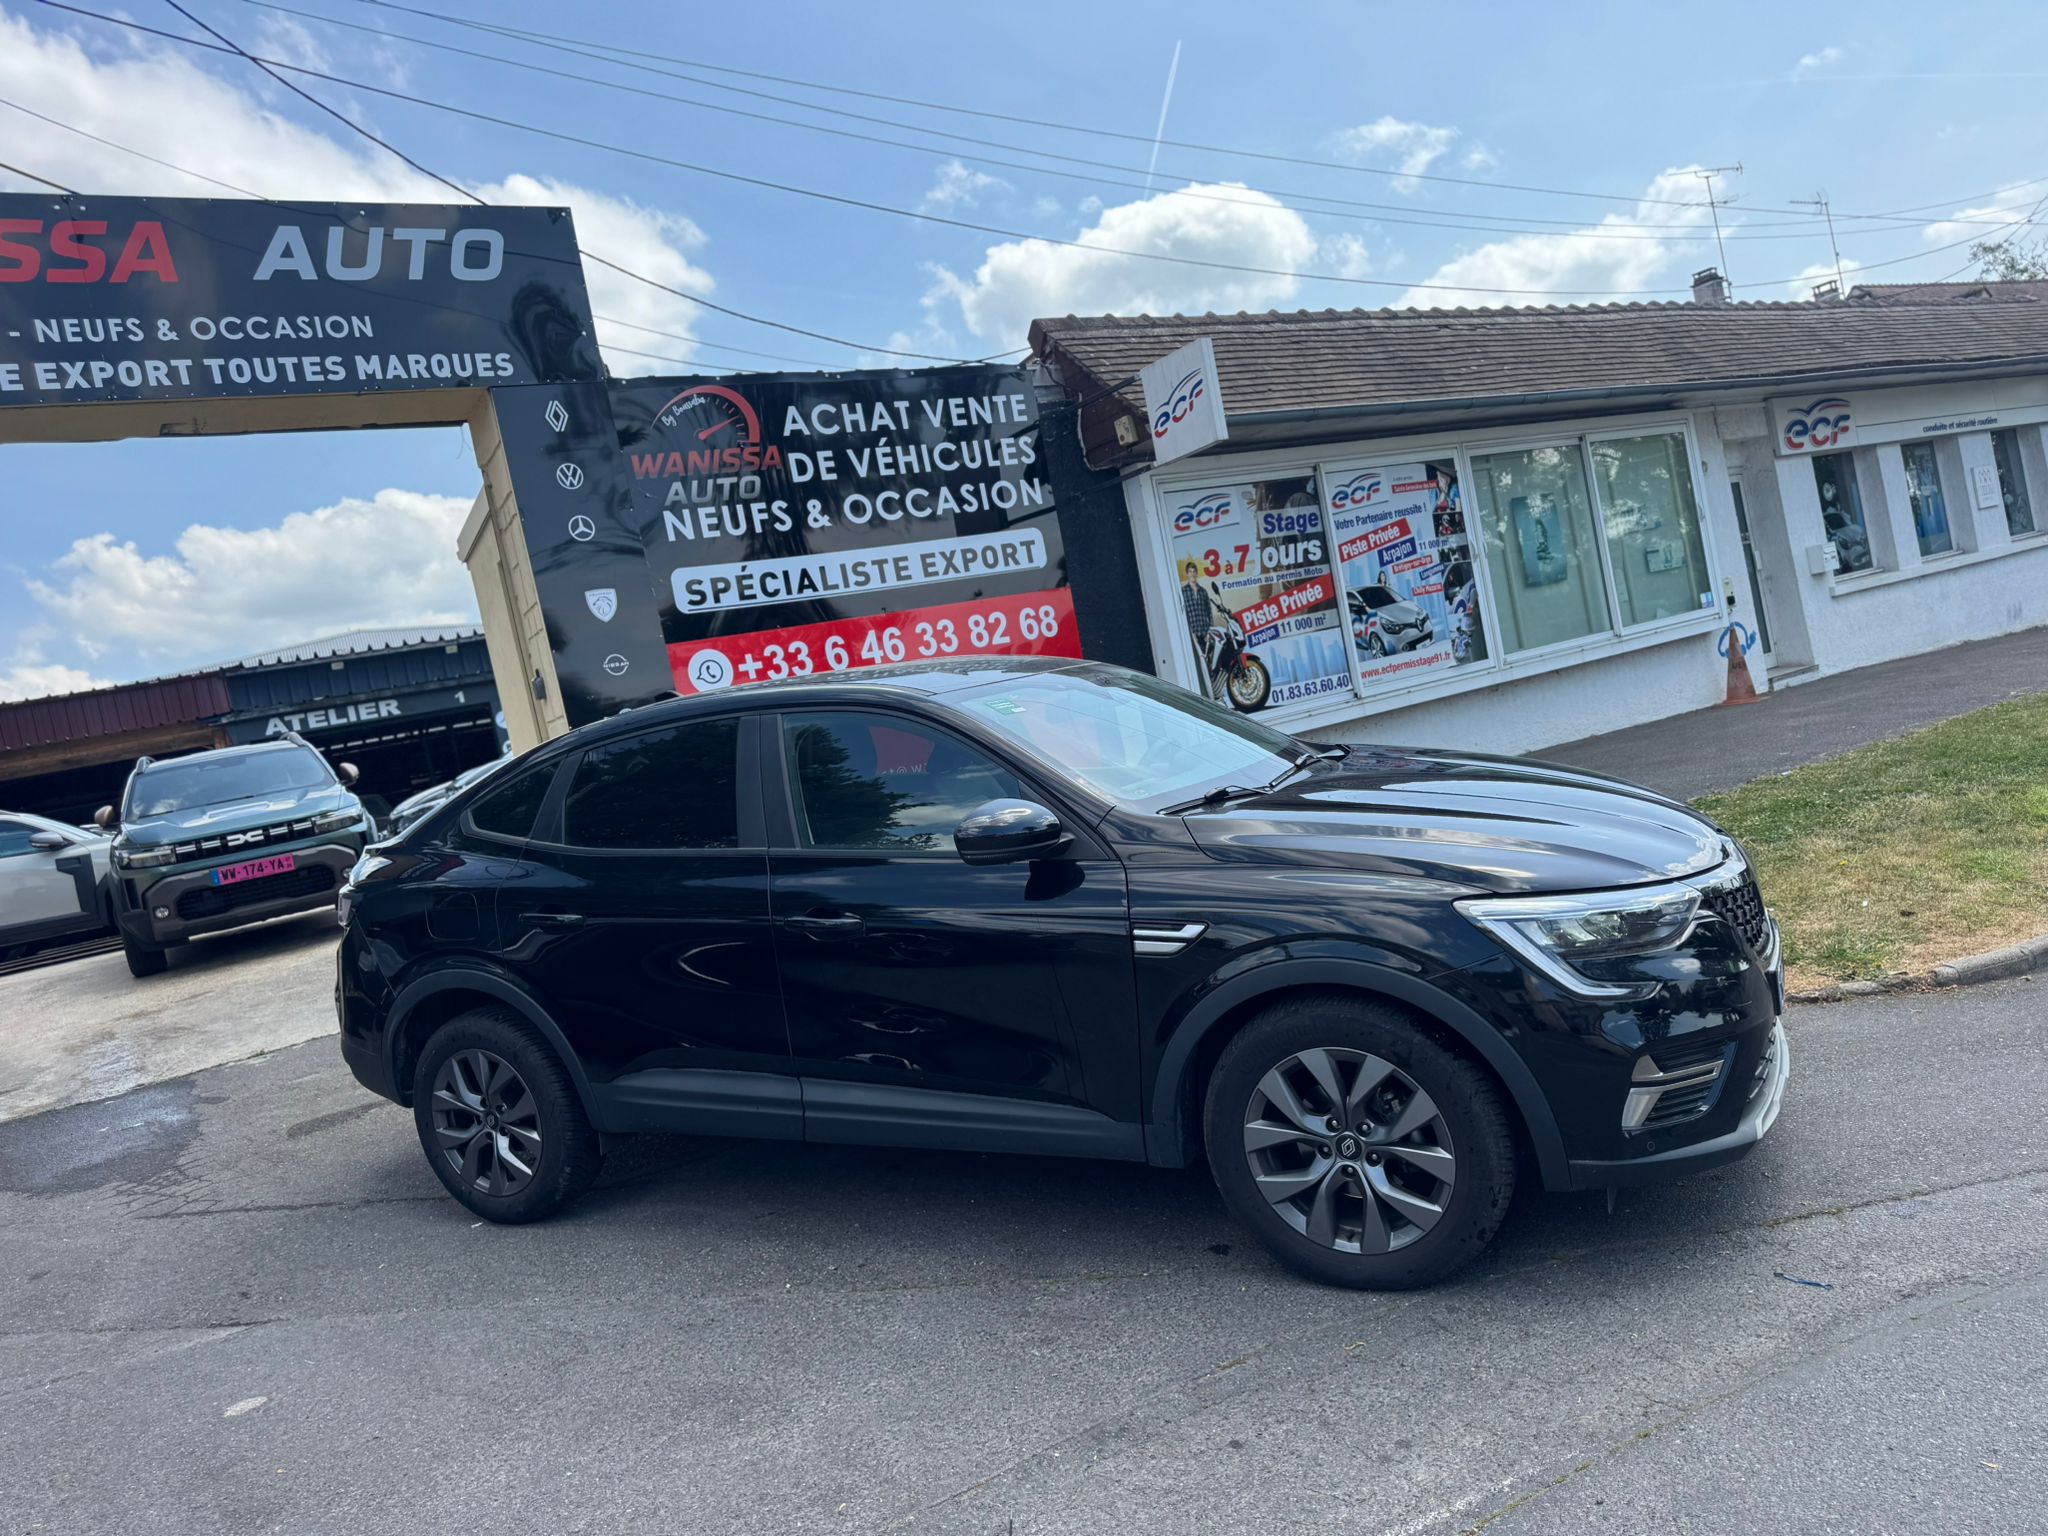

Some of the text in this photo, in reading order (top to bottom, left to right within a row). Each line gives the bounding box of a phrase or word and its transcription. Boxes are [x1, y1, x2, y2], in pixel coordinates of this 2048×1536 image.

[252, 225, 504, 281] AUTO
[34, 317, 145, 343] NEUFS
[156, 318, 180, 342] &
[190, 315, 374, 340] OCCASION
[34, 359, 193, 391] EXPORT
[203, 355, 346, 385] TOUTES
[354, 352, 514, 380] MARQUES
[783, 394, 1028, 437] ACHAT VENTE
[1923, 422, 1947, 432] conduite
[1955, 418, 1977, 428] sécurité
[1977, 416, 1998, 426] routière
[631, 445, 783, 480] WANISSA
[788, 435, 1036, 483] DE VÉHICULES
[664, 475, 761, 506] AUTO
[662, 477, 1044, 542] NEUFS & OCCASION
[1263, 512, 1319, 535] Stage
[1334, 518, 1355, 530] Votre
[1356, 510, 1393, 526] Partenaire
[1203, 539, 1322, 577] 3 à 7 jours
[1341, 525, 1400, 559] Piste Privée
[1383, 542, 1412, 562] Arpajon
[684, 540, 1036, 606] SPÉCIALISTE EXPORT
[1222, 568, 1323, 590] Formation au permis Moto
[1242, 582, 1324, 631] Piste Privée
[738, 604, 1059, 680] +33 6 46 33 82 68
[1250, 628, 1276, 646] Arpajon
[1280, 621, 1292, 634] 11
[1295, 616, 1313, 631] 000
[1361, 651, 1451, 679] www.ecfpermisstage91.fr
[1272, 674, 1350, 703] 01.83.63.60.40
[265, 690, 466, 736] ATELIER 1
